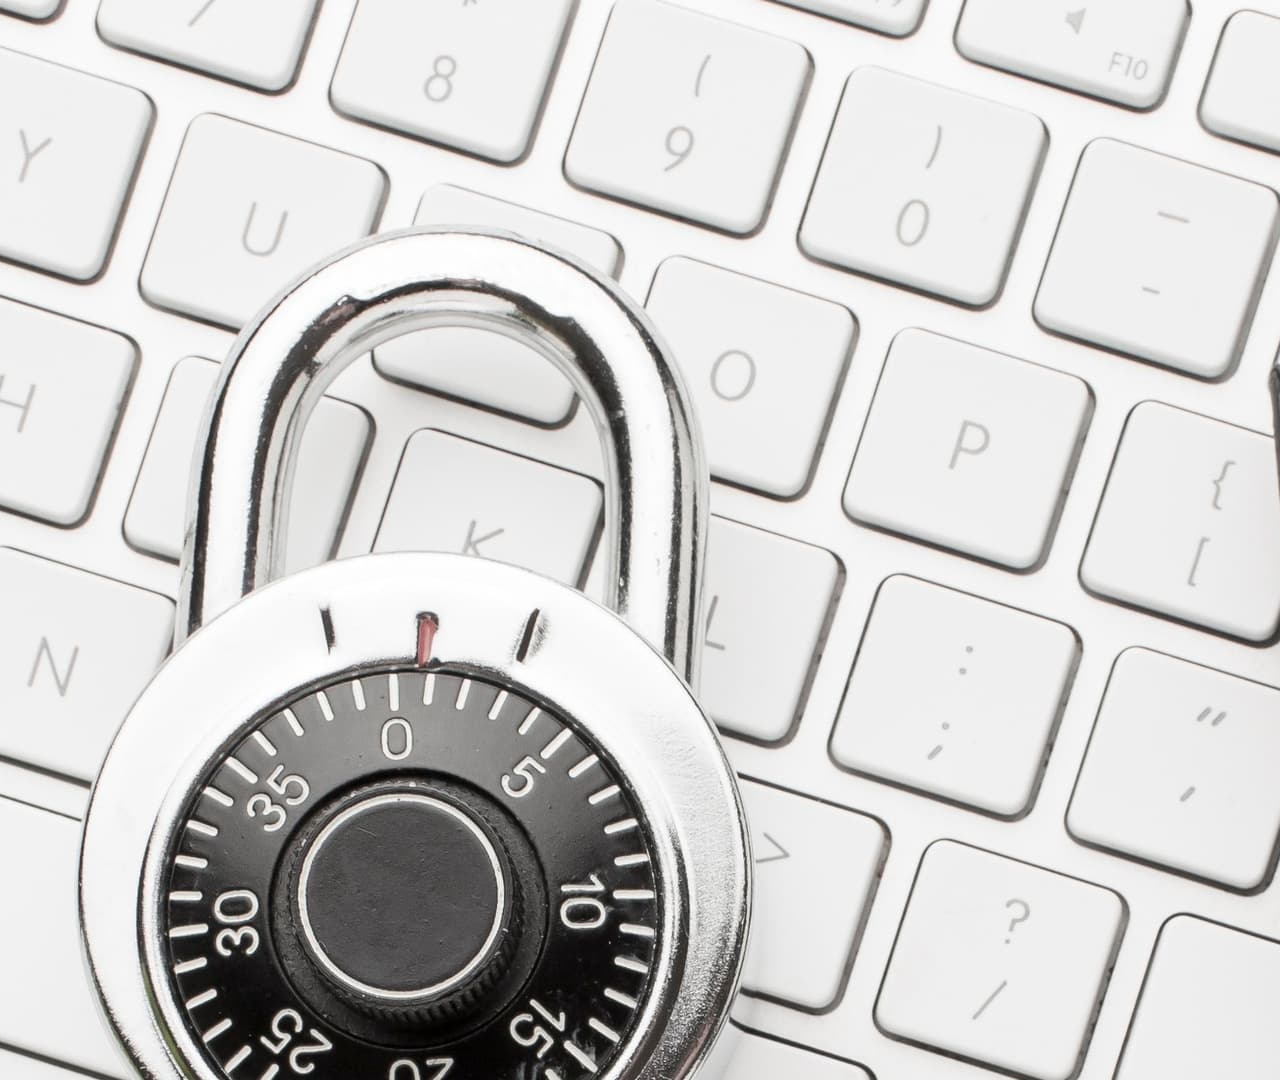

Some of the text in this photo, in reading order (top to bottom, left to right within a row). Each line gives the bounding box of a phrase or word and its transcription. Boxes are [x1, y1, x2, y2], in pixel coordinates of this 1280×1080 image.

[423, 55, 457, 103] 8
[1108, 51, 1149, 81] F10
[18, 129, 53, 183] Y
[663, 125, 695, 173] 9
[241, 201, 289, 258] U
[948, 419, 991, 470] P
[462, 519, 505, 557] K
[704, 594, 727, 652] L
[26, 636, 80, 698] N
[379, 717, 415, 762] 0
[245, 763, 311, 833] 35
[501, 757, 547, 800] 5
[213, 889, 260, 957] 30
[559, 874, 607, 930] 10
[1004, 898, 1031, 945] ?
[260, 1007, 335, 1077] 25
[509, 999, 567, 1060] 15
